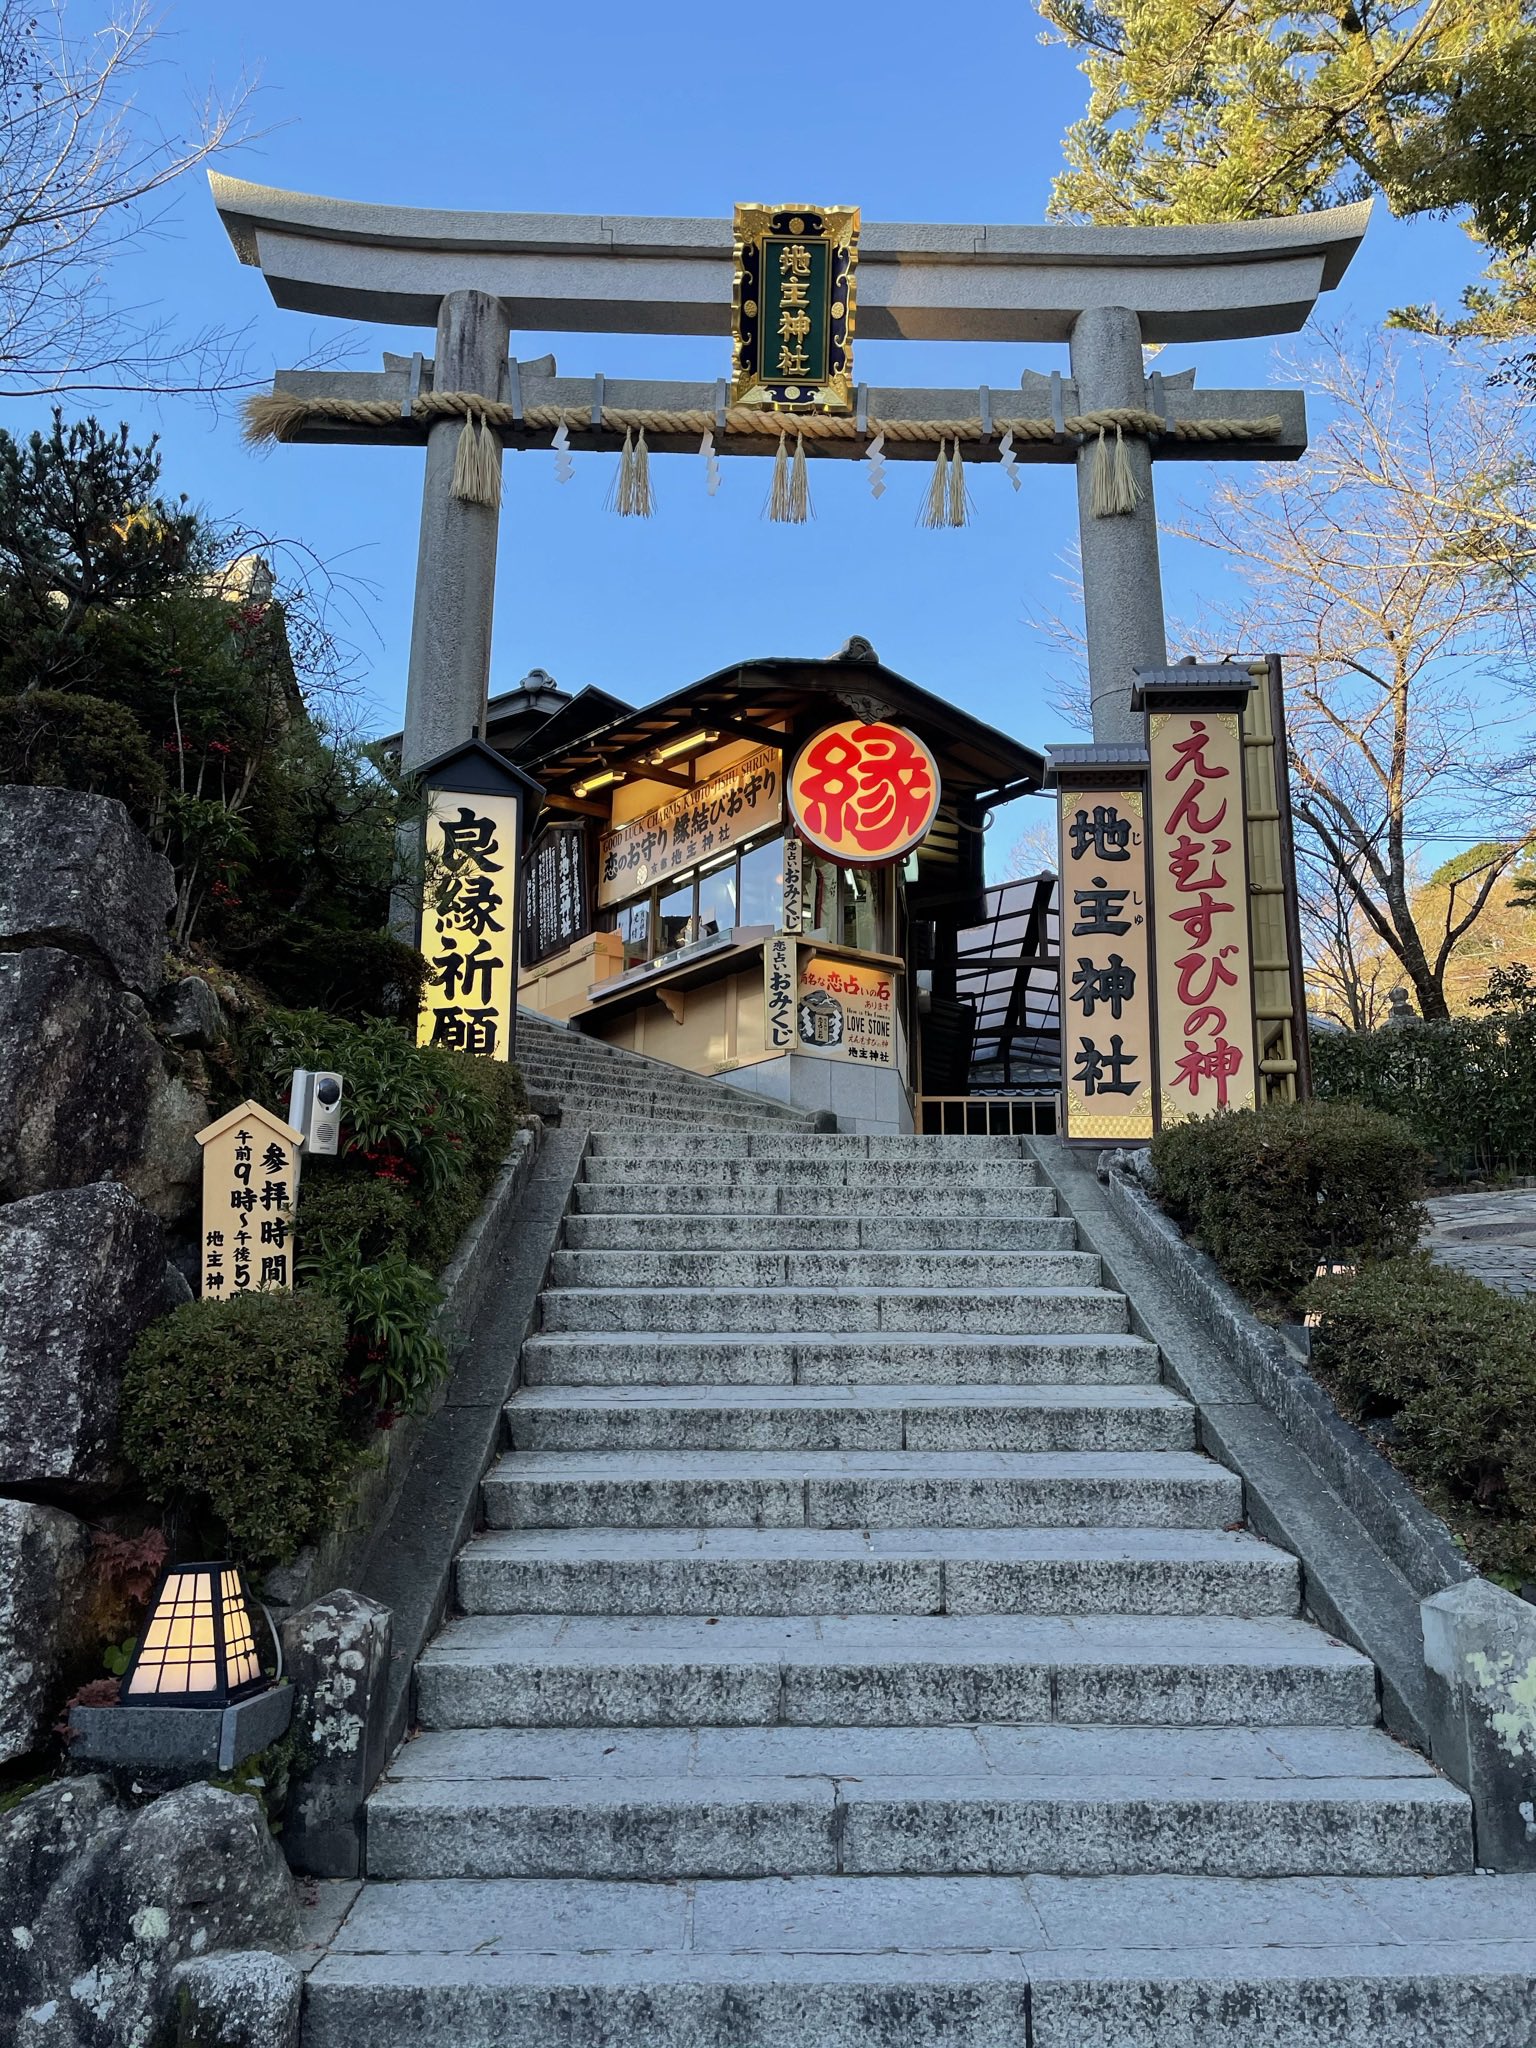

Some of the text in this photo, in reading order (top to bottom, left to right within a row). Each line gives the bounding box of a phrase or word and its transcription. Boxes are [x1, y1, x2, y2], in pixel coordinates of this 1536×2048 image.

[777, 244, 813, 377] 地主神社
[603, 832, 623, 853] GOOD
[625, 820, 645, 842] LUCK
[647, 800, 681, 829] CHARMS
[741, 748, 777, 774] SHRINE
[603, 768, 776, 883] 恋のお守り 縁結びお守り
[799, 725, 931, 851] 縁
[431, 808, 505, 1054] 良縁祈願
[784, 841, 800, 930] 恋占いおみくじ
[1165, 720, 1243, 1108] えんむすびの神
[769, 940, 793, 1046] 恋占いおみくじ
[800, 971, 891, 1001] 有名な恋占いの石
[1070, 806, 1141, 1096] 地主神社
[846, 1015, 865, 1033] LOVE
[868, 1018, 891, 1037] STONE
[848, 1046, 890, 1062] 地主神社
[205, 1230, 225, 1301] 地主神
[230, 1130, 258, 1299] 午前9時〜午後5
[259, 1143, 290, 1287] 参拝時間
